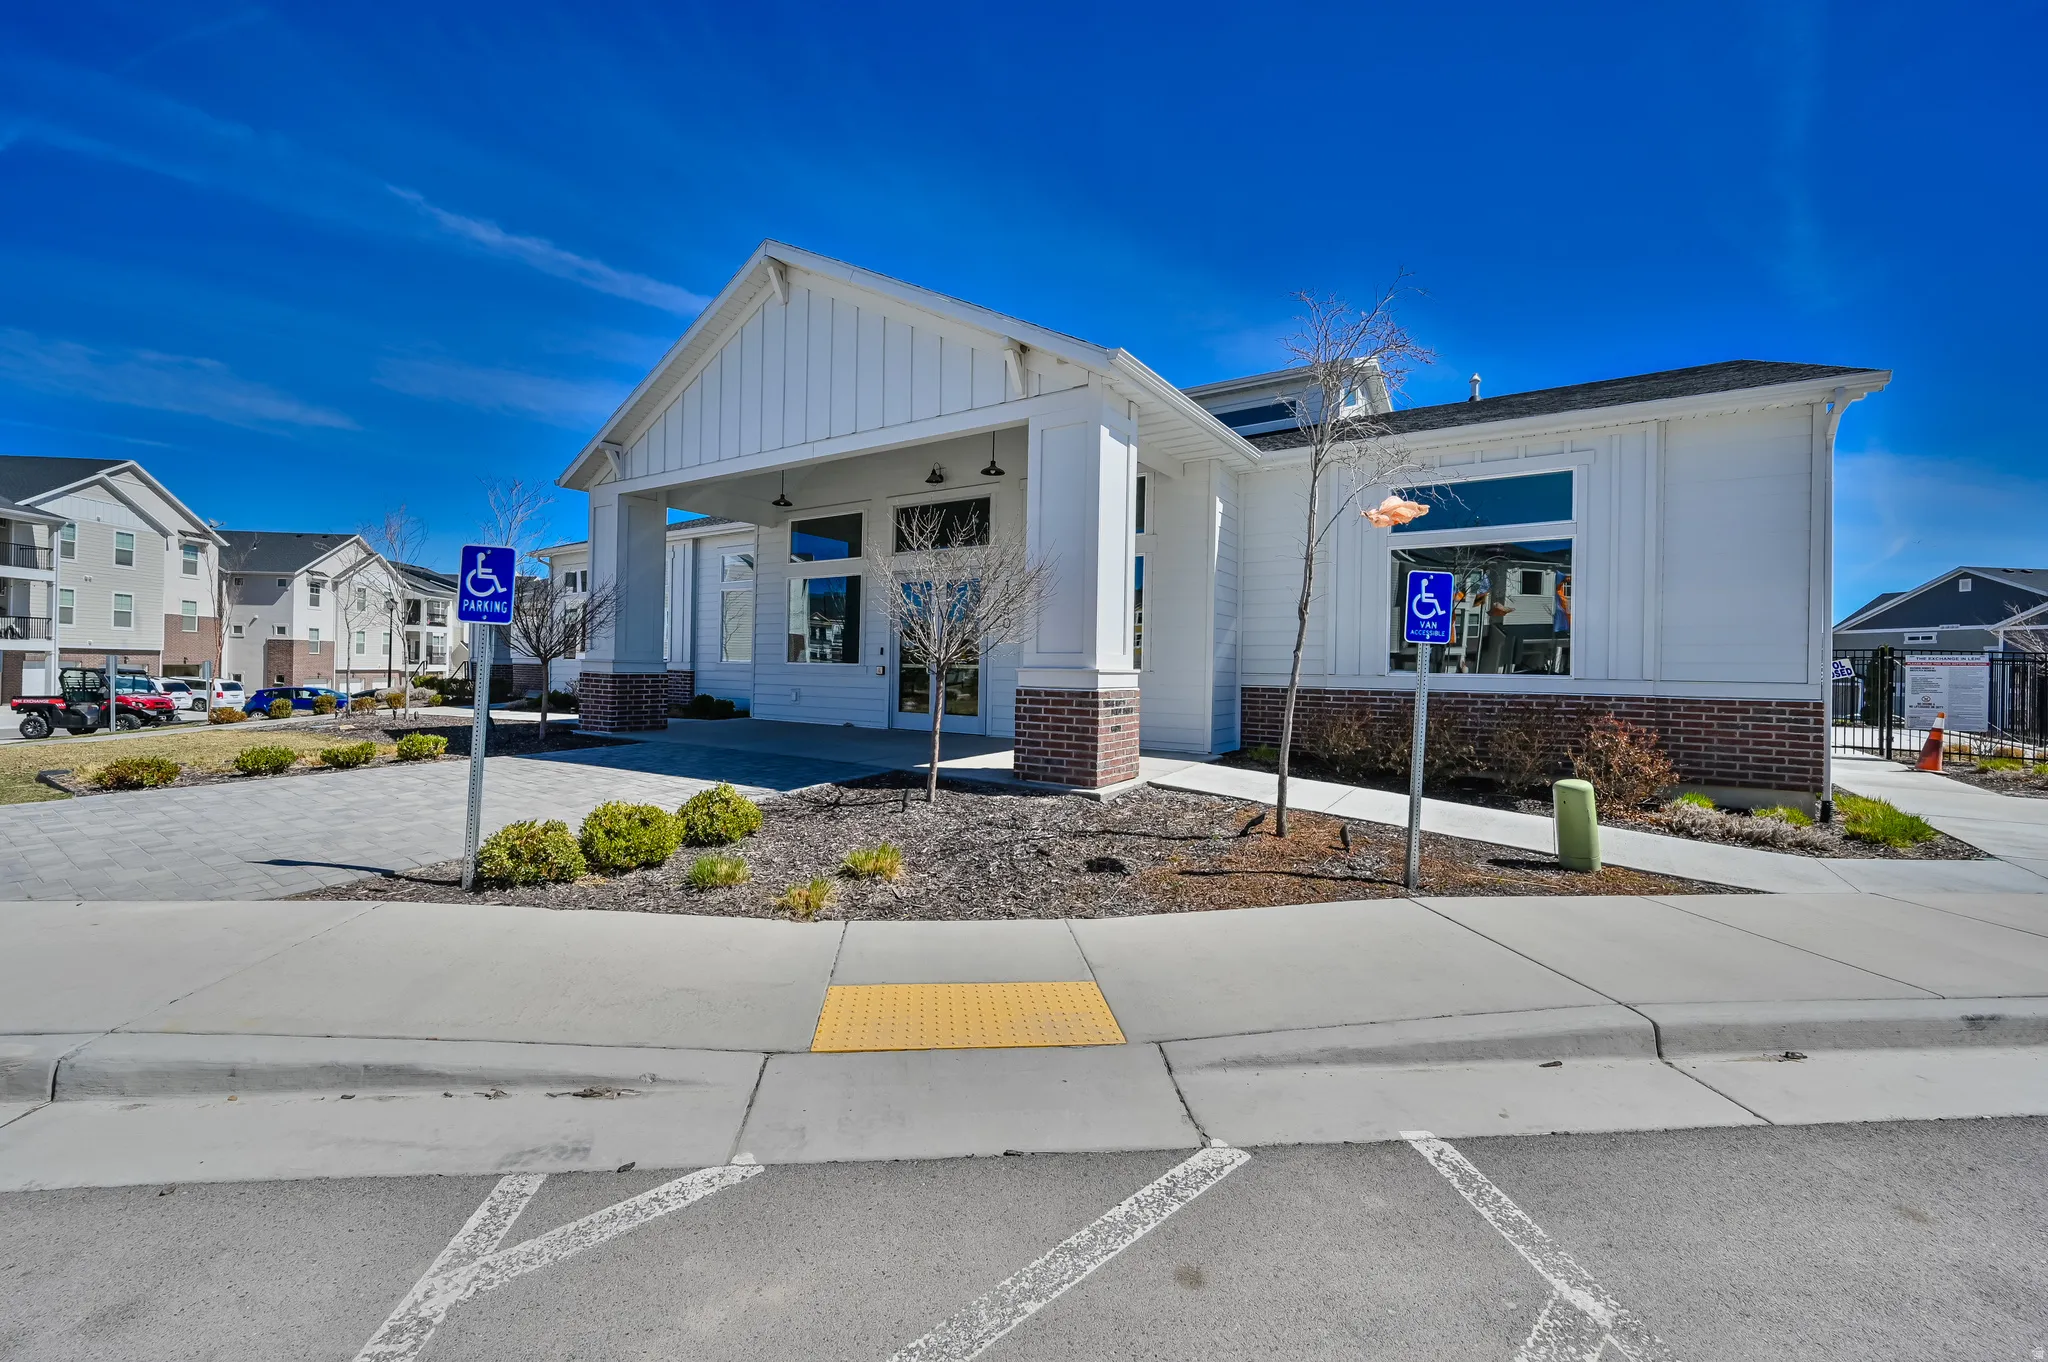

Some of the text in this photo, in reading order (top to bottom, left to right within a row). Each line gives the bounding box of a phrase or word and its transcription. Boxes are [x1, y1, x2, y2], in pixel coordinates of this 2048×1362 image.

[462, 599, 508, 613] PARKING
[1420, 621, 1437, 629] VAN
[1410, 629, 1445, 637] ACCESSIBLE
